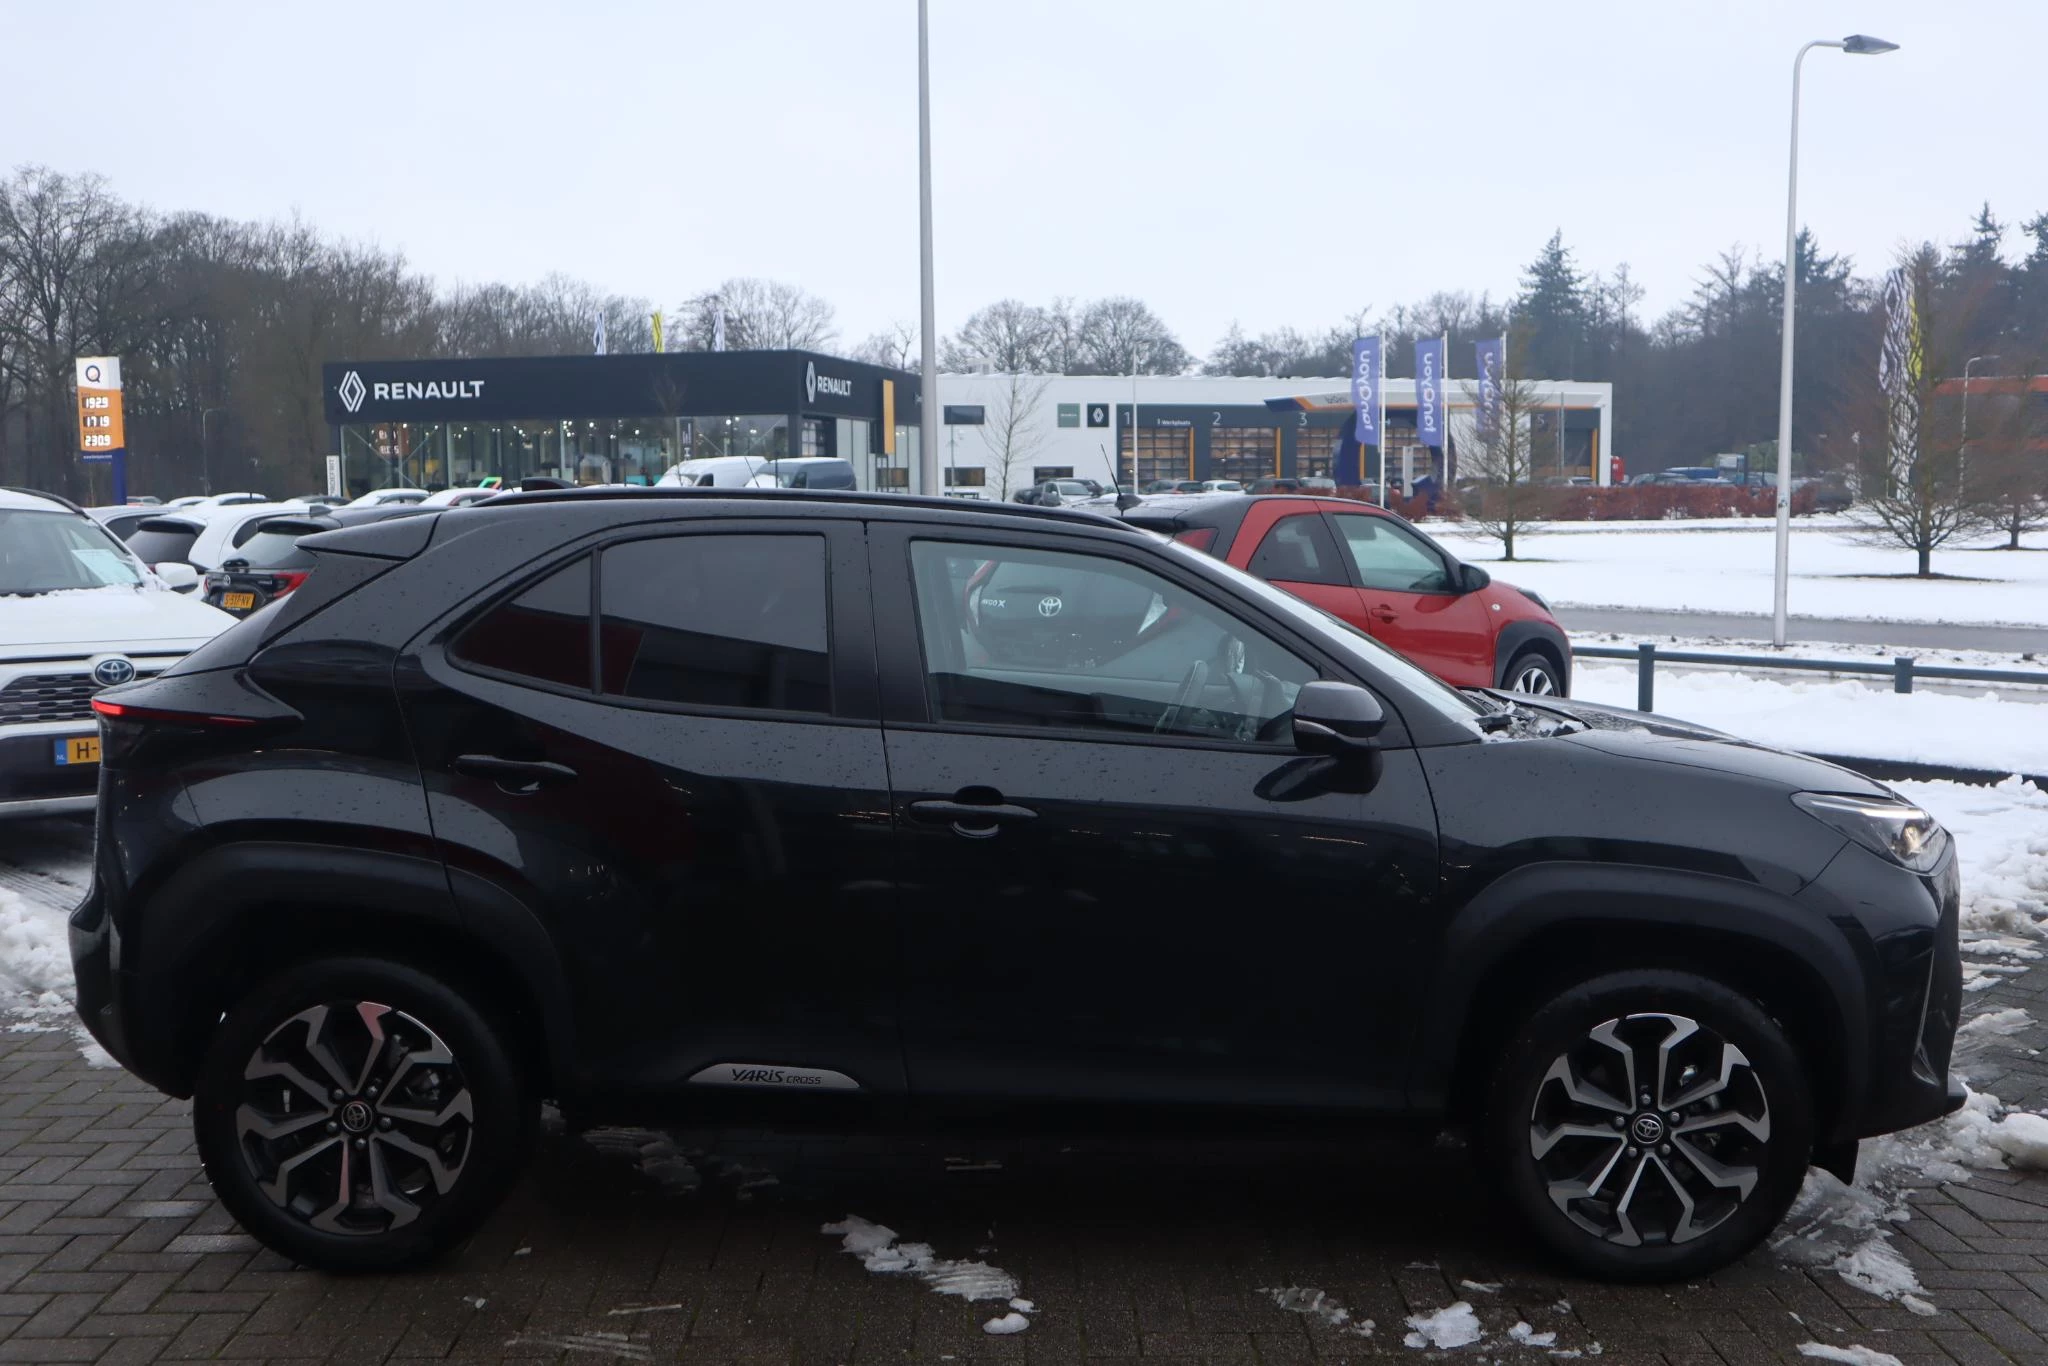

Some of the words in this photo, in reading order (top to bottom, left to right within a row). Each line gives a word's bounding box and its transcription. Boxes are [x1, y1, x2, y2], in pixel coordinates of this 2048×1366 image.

[374, 380, 485, 400] RENAULT
[817, 375, 852, 397] RENAULT
[1124, 411, 1131, 425] 1
[1212, 411, 1222, 426] 2
[1299, 412, 1308, 426] 3
[786, 1075, 822, 1085] CROSS
